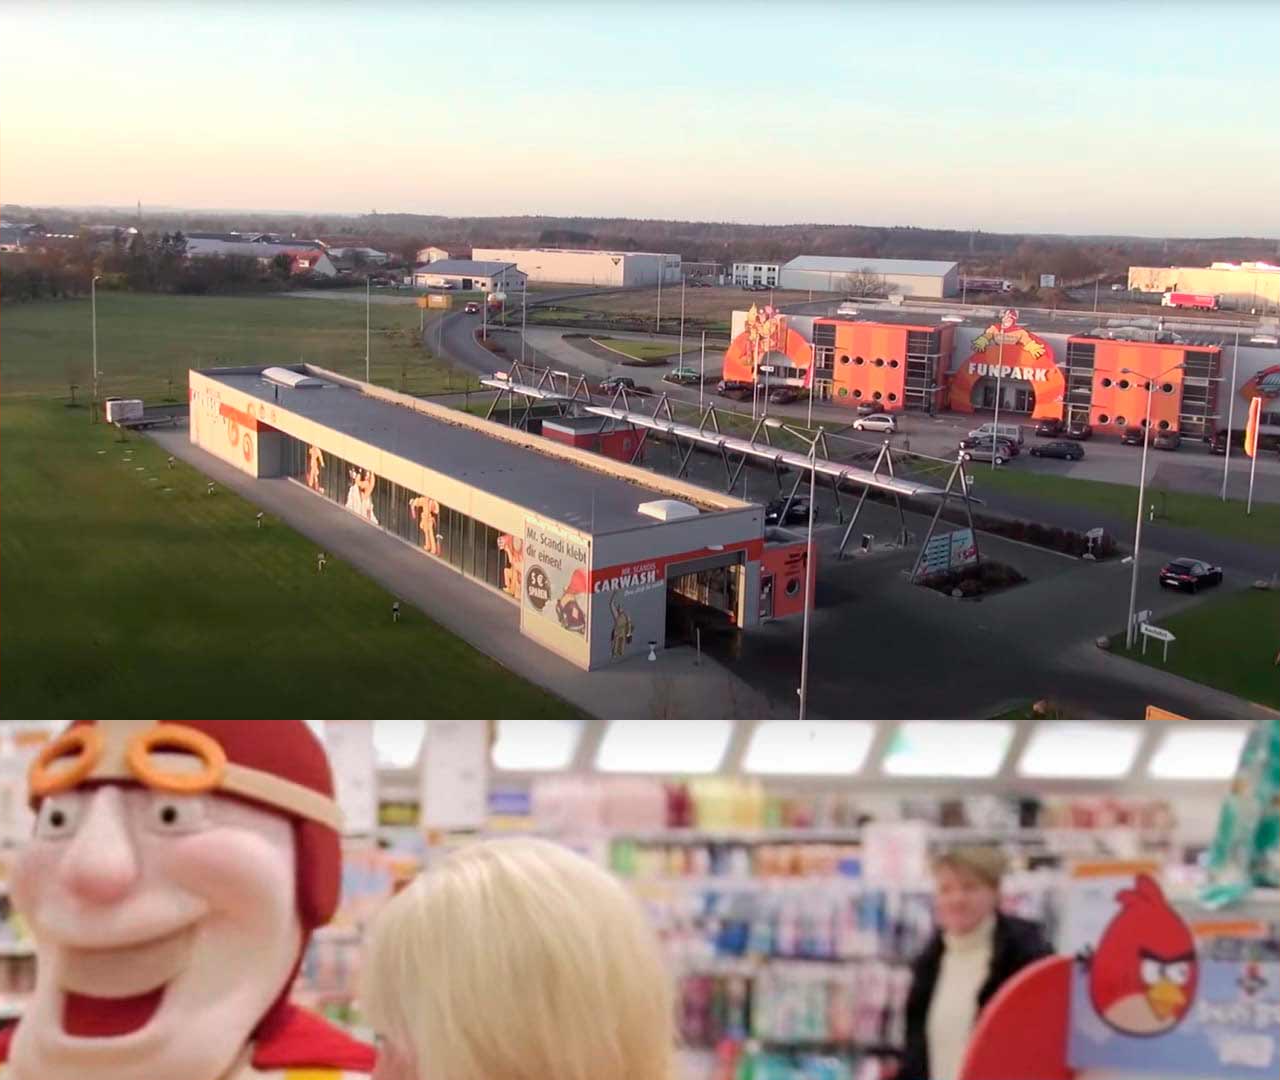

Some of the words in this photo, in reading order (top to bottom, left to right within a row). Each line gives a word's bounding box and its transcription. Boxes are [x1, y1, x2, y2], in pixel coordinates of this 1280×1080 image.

[969, 362, 1048, 382] FUNPARK
[526, 543, 537, 558] dir
[538, 550, 562, 571] einen!
[540, 532, 564, 551] Scandi
[566, 541, 587, 565] klebt
[594, 570, 656, 593] CARWASH
